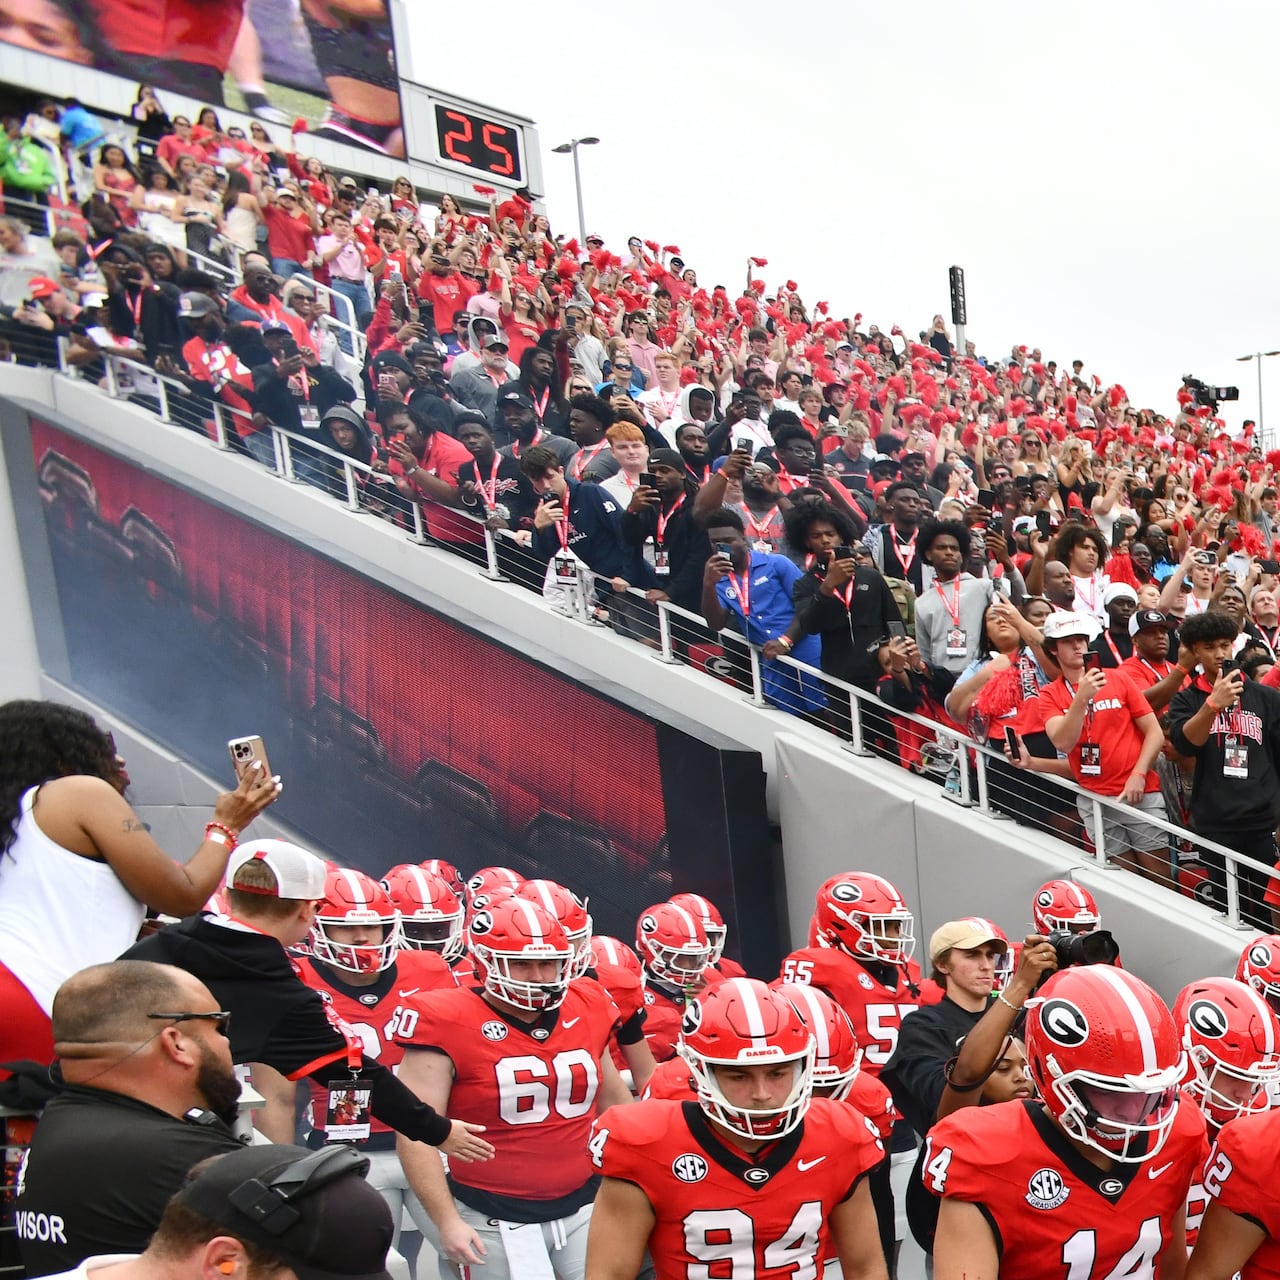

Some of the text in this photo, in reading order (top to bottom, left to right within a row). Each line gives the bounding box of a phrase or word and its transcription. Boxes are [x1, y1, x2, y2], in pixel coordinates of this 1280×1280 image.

[443, 110, 515, 176] 25
[1208, 712, 1263, 745] ULLDOGS
[832, 883, 862, 903] G
[472, 911, 492, 935] G
[1248, 944, 1271, 968] G
[783, 960, 816, 986] 55
[391, 1005, 420, 1038] 60
[483, 1022, 507, 1040] SEC
[681, 998, 702, 1036] G
[1041, 1000, 1088, 1047] G
[1189, 1000, 1227, 1038] G
[746, 1049, 778, 1058] DAWGS
[495, 1048, 599, 1125] 60
[674, 1155, 706, 1181] SEC
[1030, 1170, 1062, 1200] SEC
[1030, 1191, 1068, 1209] GRADUATE
